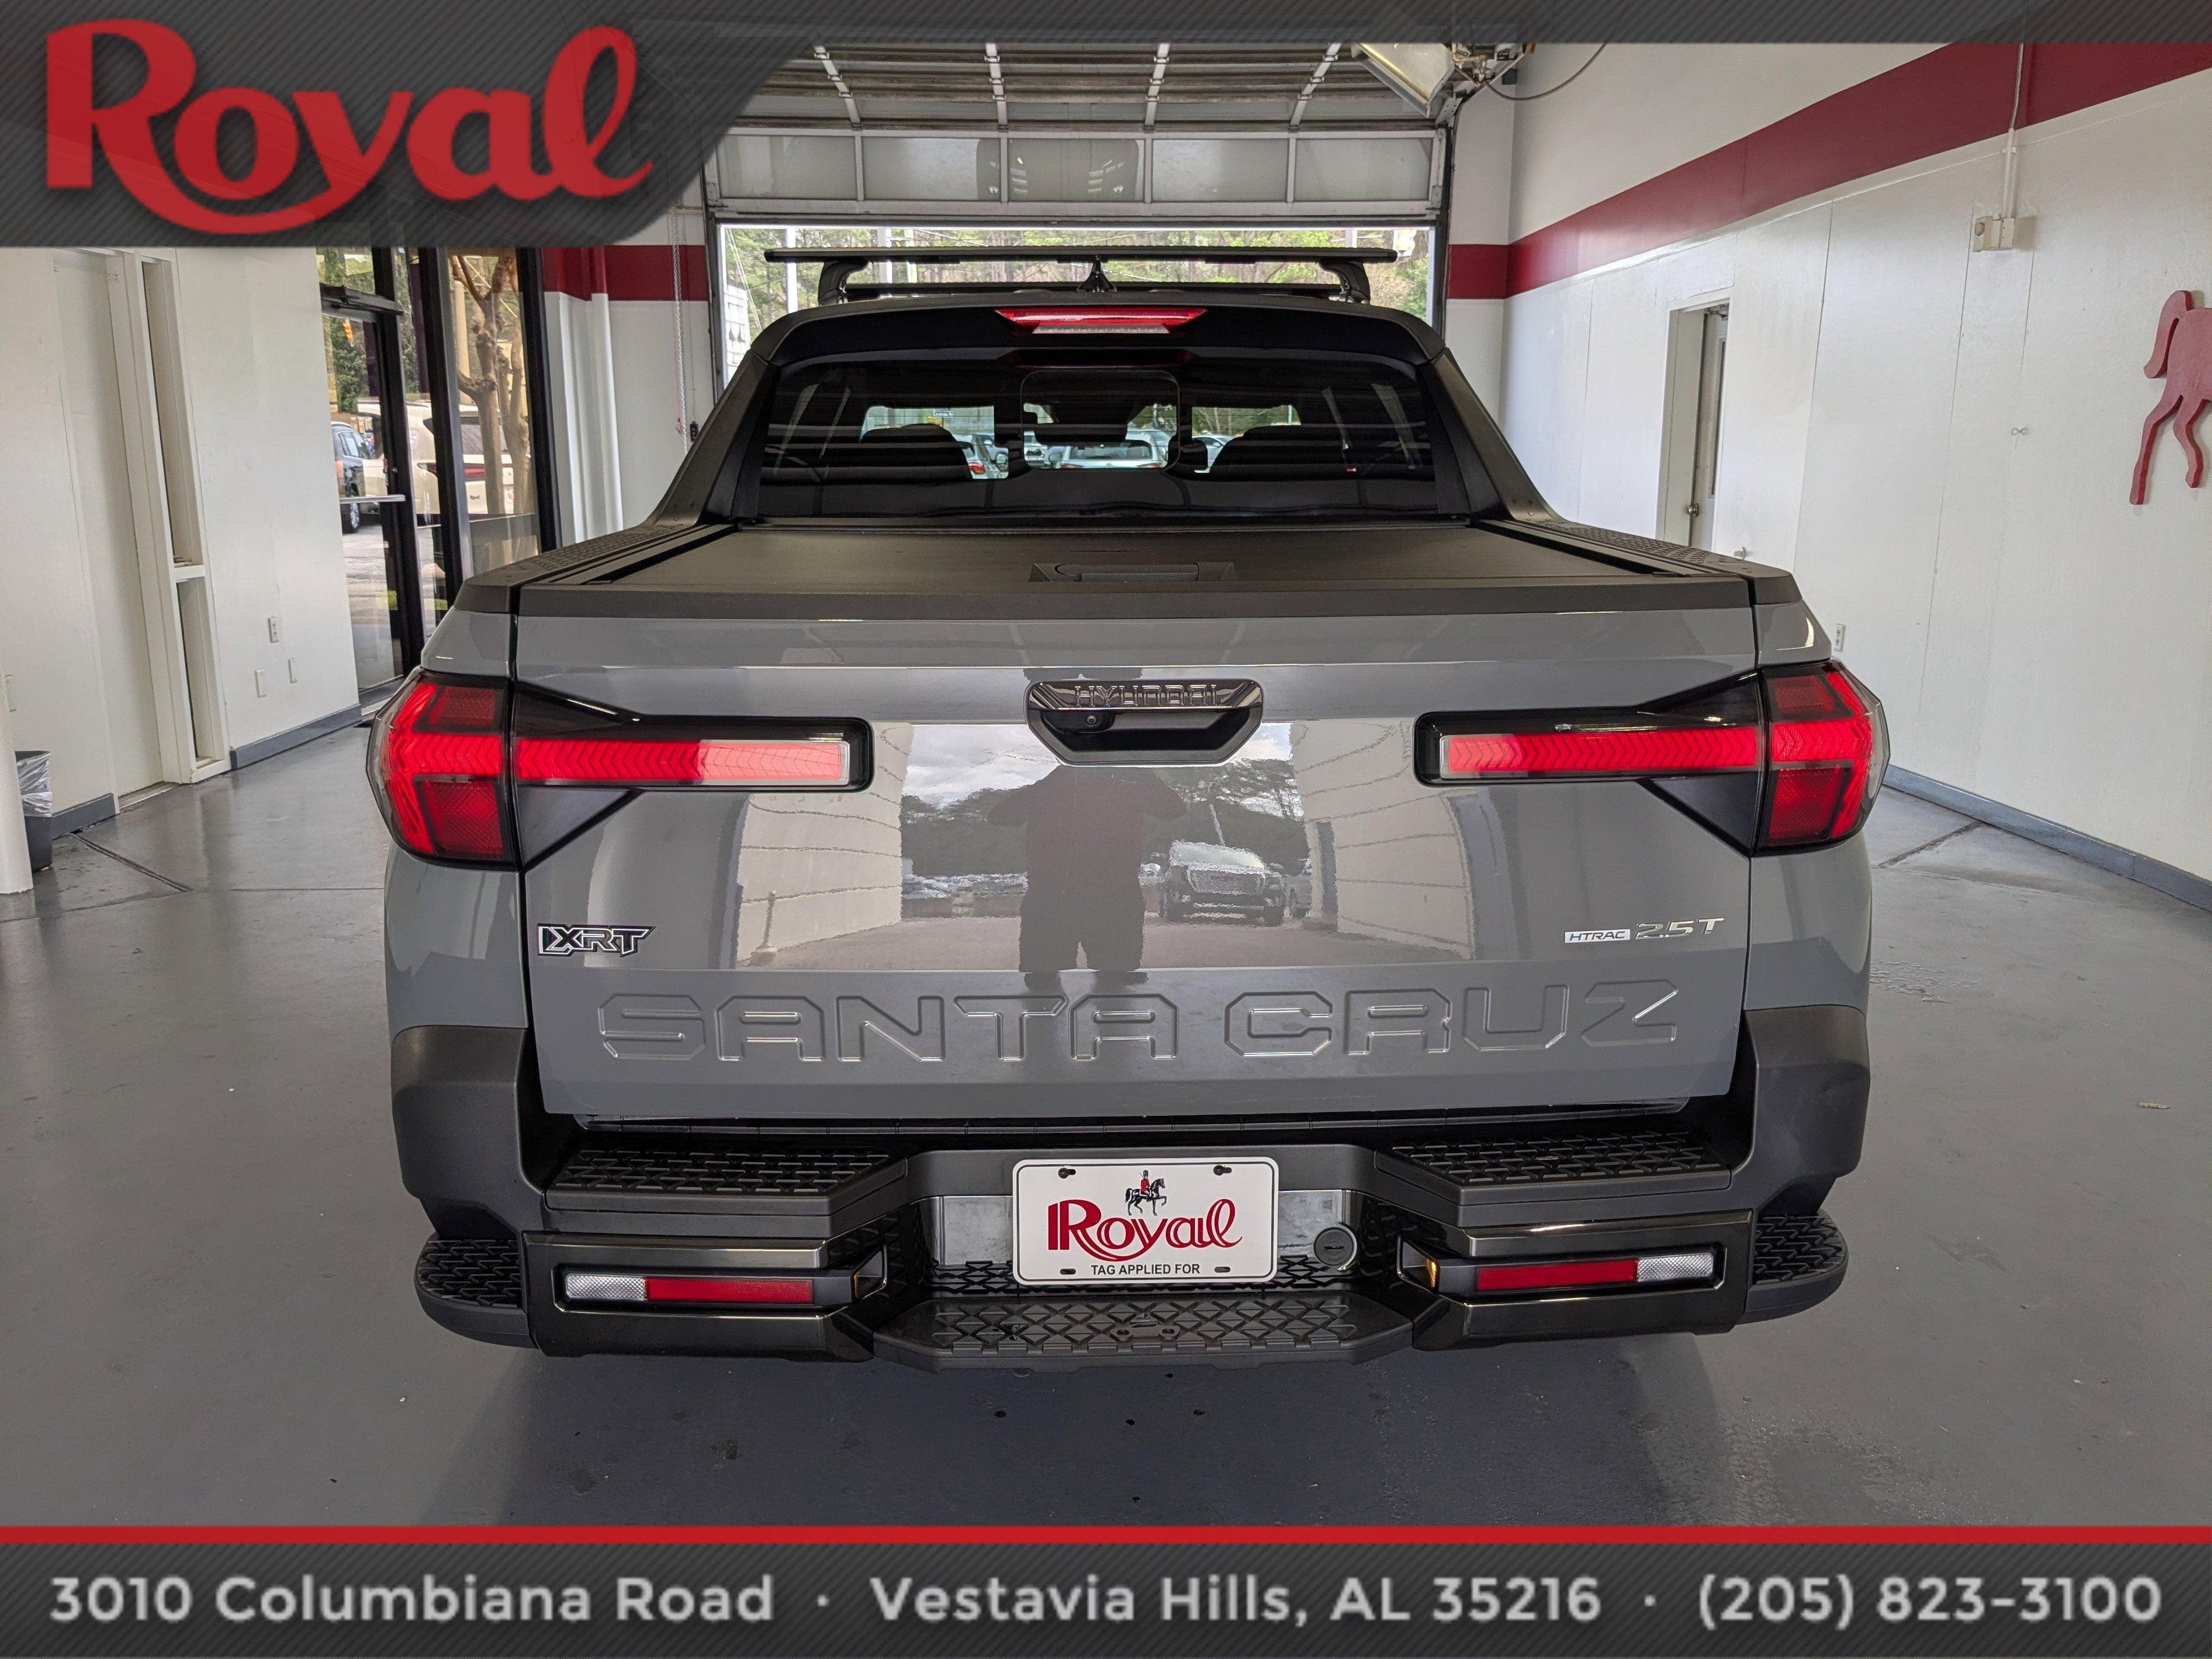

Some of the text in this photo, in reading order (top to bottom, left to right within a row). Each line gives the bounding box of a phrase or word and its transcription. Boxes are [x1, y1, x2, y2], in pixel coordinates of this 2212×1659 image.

[1074, 684, 1217, 707] HYUNDAI
[1569, 931, 1626, 941] HTRAC
[598, 979, 1678, 1063] SANTA CRUZ
[1047, 1198, 1243, 1262] Royal
[1091, 1263, 1200, 1274] TAG APPLIED FOR
